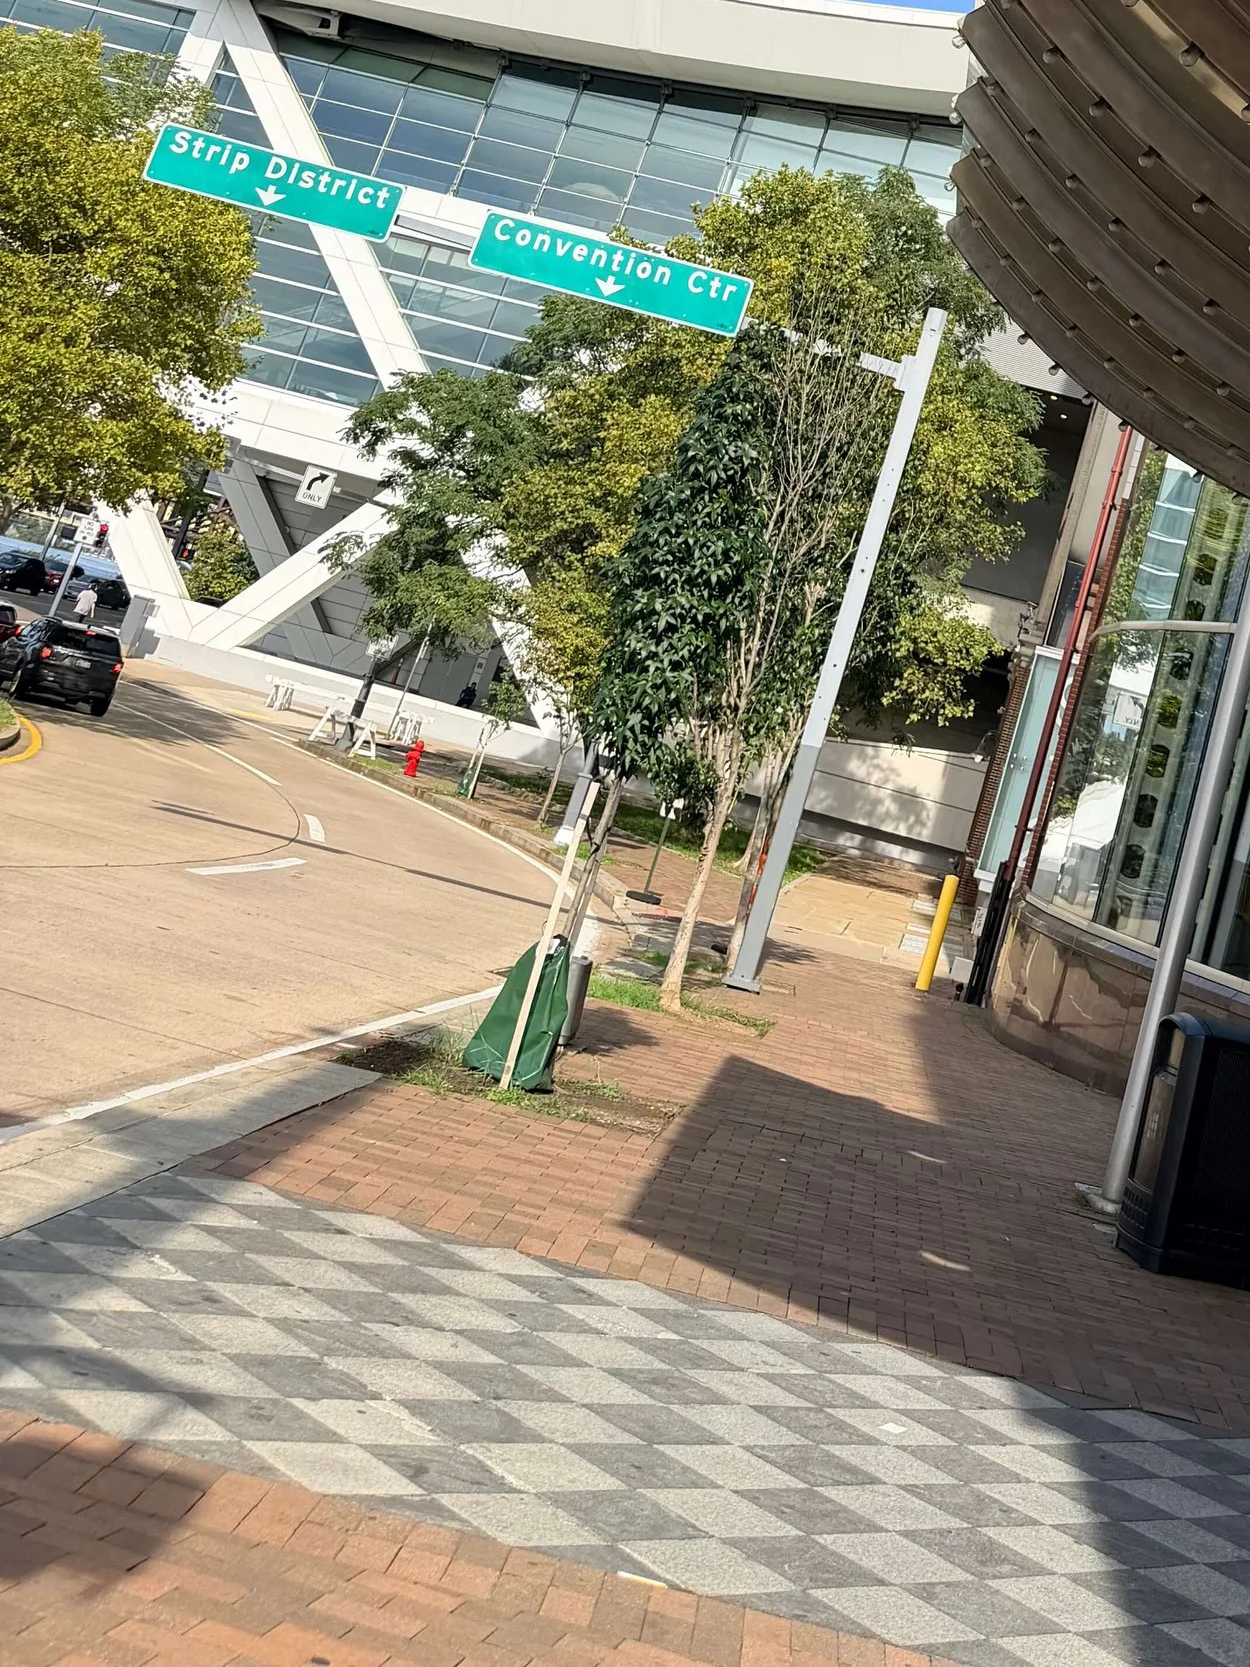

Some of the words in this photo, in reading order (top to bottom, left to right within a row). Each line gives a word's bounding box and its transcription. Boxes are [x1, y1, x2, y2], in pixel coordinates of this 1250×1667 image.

[169, 131, 250, 174] Strip
[264, 156, 391, 209] District
[494, 218, 672, 286] Convention
[687, 271, 738, 302] Ctr
[302, 492, 322, 502] ONLY
